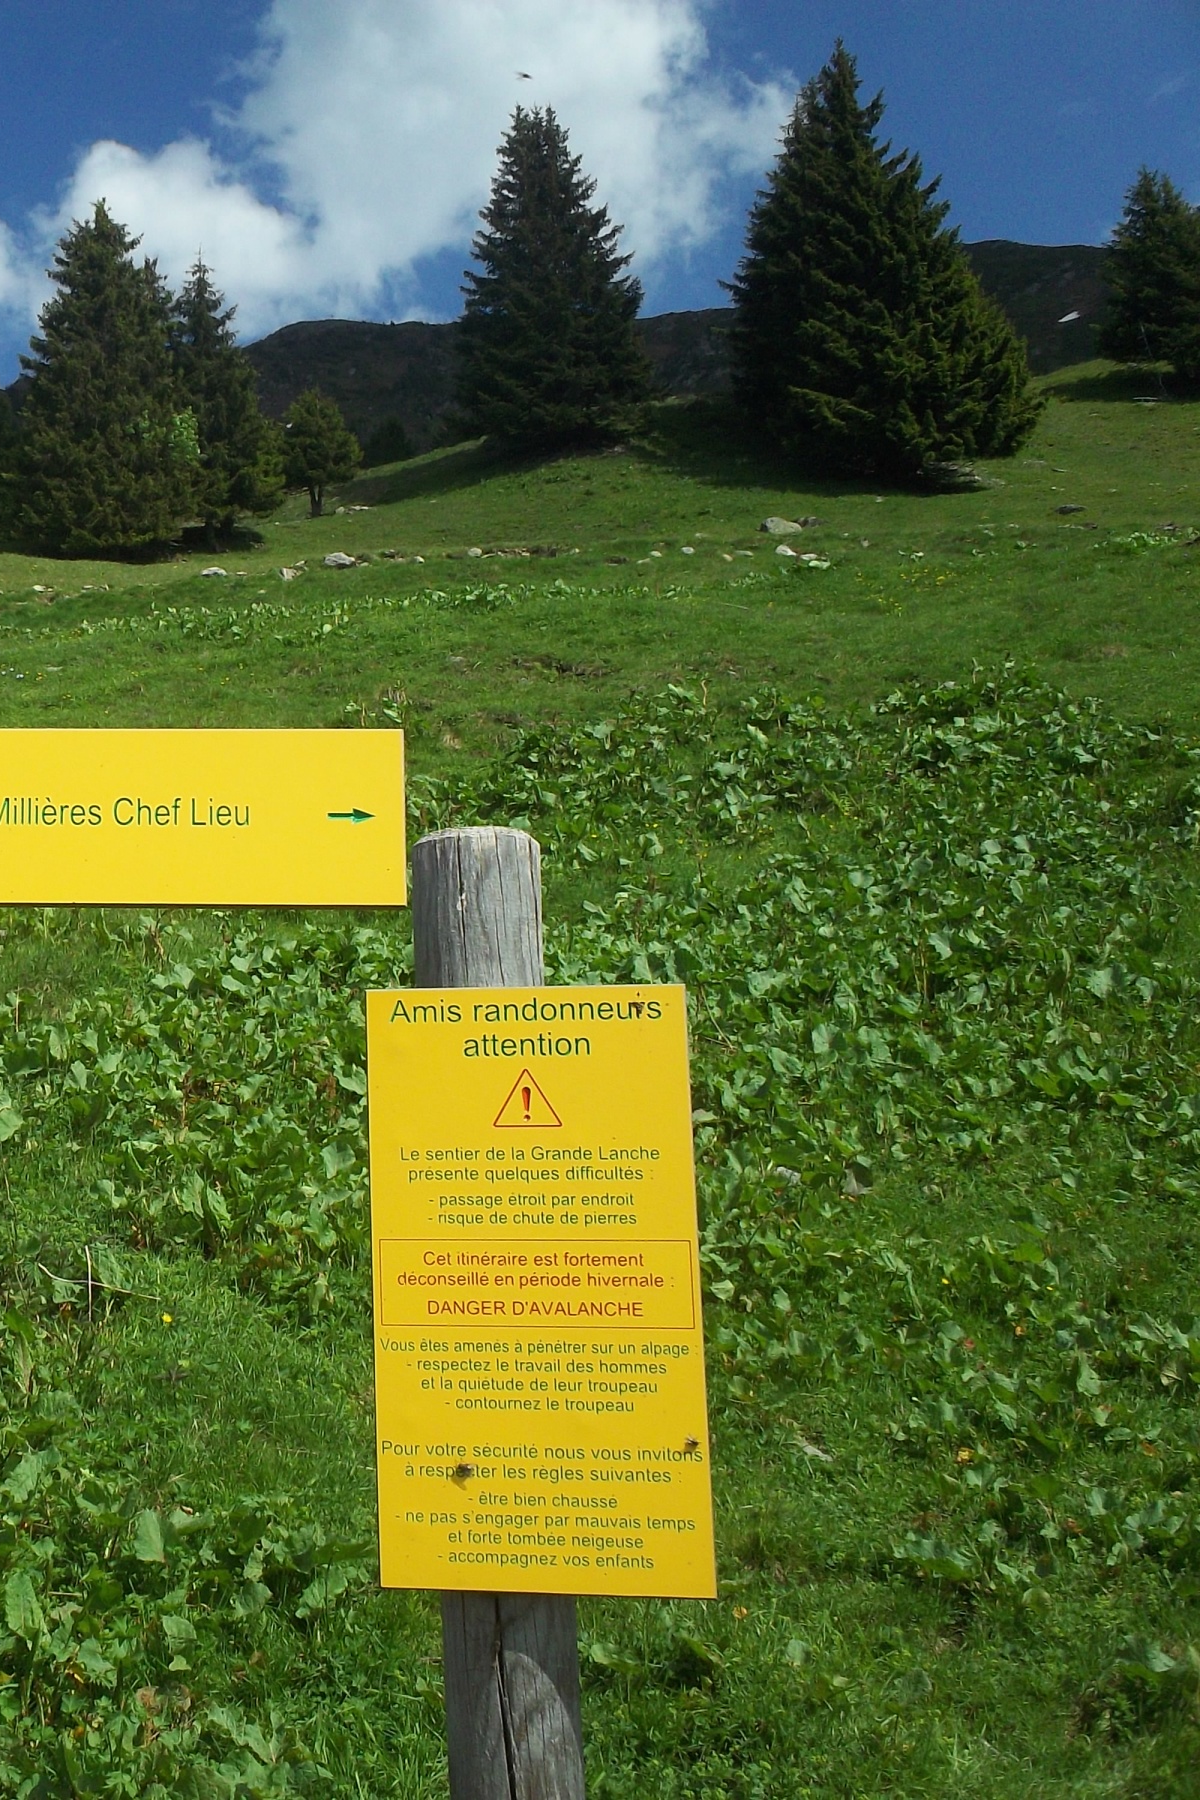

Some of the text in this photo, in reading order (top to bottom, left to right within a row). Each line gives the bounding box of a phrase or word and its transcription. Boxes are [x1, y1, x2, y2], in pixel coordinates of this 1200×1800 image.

[114, 798, 181, 825] Chef
[192, 798, 249, 826] Lieu
[391, 997, 661, 1023] Amis randonneurs
[464, 1032, 590, 1057] attention
[401, 1146, 659, 1161] Le sentier de la Grande Lanche
[409, 1166, 479, 1183] présente
[485, 1166, 559, 1184] quelques
[566, 1166, 643, 1180] difficultés
[440, 1196, 502, 1209] passage
[509, 1192, 546, 1206] étroit
[552, 1196, 576, 1209] par
[581, 1192, 634, 1206] endroit
[439, 1211, 483, 1227] risque
[489, 1211, 507, 1224] de
[513, 1211, 554, 1224] chute
[560, 1211, 578, 1224] de
[584, 1211, 636, 1227] pierres
[423, 1251, 644, 1266] Cet itinéraire est fortement
[398, 1271, 489, 1286] déconseillé
[495, 1275, 514, 1286] en
[519, 1272, 581, 1289] période
[587, 1272, 664, 1287] hivernale
[428, 1301, 643, 1317] DANGER D'AVALANCHE
[380, 1338, 415, 1351] Vous
[420, 1338, 449, 1352] êtes
[454, 1339, 509, 1353] amenés
[515, 1339, 522, 1353] à
[528, 1339, 587, 1356] pénétrer
[591, 1344, 614, 1354] sur
[619, 1344, 635, 1354] un
[641, 1341, 689, 1358] alpage
[418, 1358, 491, 1374] respectez
[496, 1358, 509, 1371] le
[515, 1359, 560, 1373] travail
[566, 1359, 594, 1373] des
[600, 1359, 666, 1374] hommes
[422, 1376, 657, 1396] et la quiétude de leur troupeau
[456, 1396, 541, 1410] contournez
[547, 1397, 559, 1410] le
[565, 1398, 633, 1414] troupeau
[382, 1441, 703, 1463] Pour votre sécurité nous vous invitons
[405, 1461, 414, 1476] à
[503, 1464, 526, 1479] les
[533, 1465, 584, 1484] règles
[590, 1467, 671, 1482] suivantes
[479, 1491, 508, 1506] être
[514, 1492, 546, 1506] bien
[552, 1493, 617, 1508] chaussé
[406, 1512, 424, 1522] ne
[430, 1513, 457, 1526] pas
[463, 1510, 539, 1529] s'engager
[545, 1516, 570, 1530] par
[575, 1517, 641, 1529] mauvais
[647, 1516, 695, 1533] temps
[449, 1529, 643, 1551] et forte tombée neigeuse
[449, 1552, 557, 1568] accompagnez
[563, 1556, 590, 1566] vos
[596, 1553, 654, 1568] enfants
